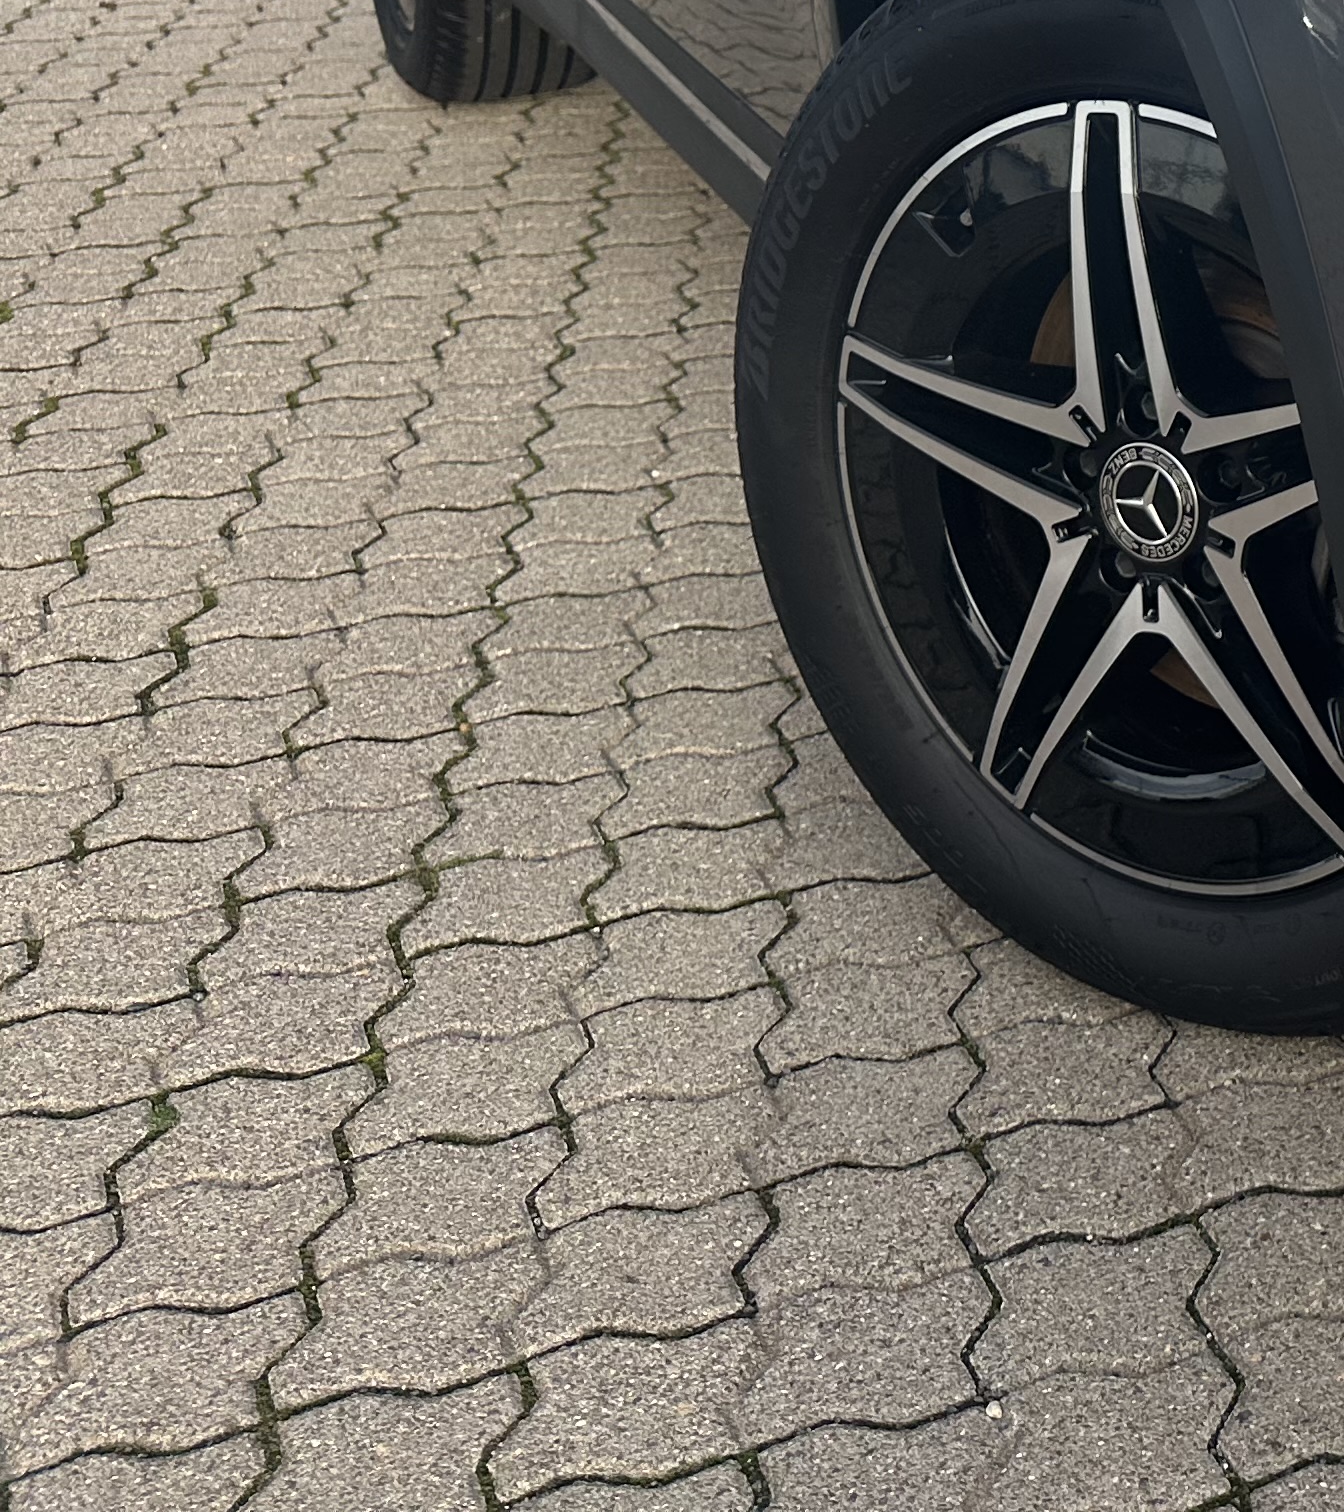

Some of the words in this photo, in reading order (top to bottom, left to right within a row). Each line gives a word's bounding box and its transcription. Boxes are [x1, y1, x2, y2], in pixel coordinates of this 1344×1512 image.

[740, 51, 912, 402] BRIDGESTONE
[1108, 448, 1138, 475] BENZ
[1141, 514, 1194, 558] MERCEDES
